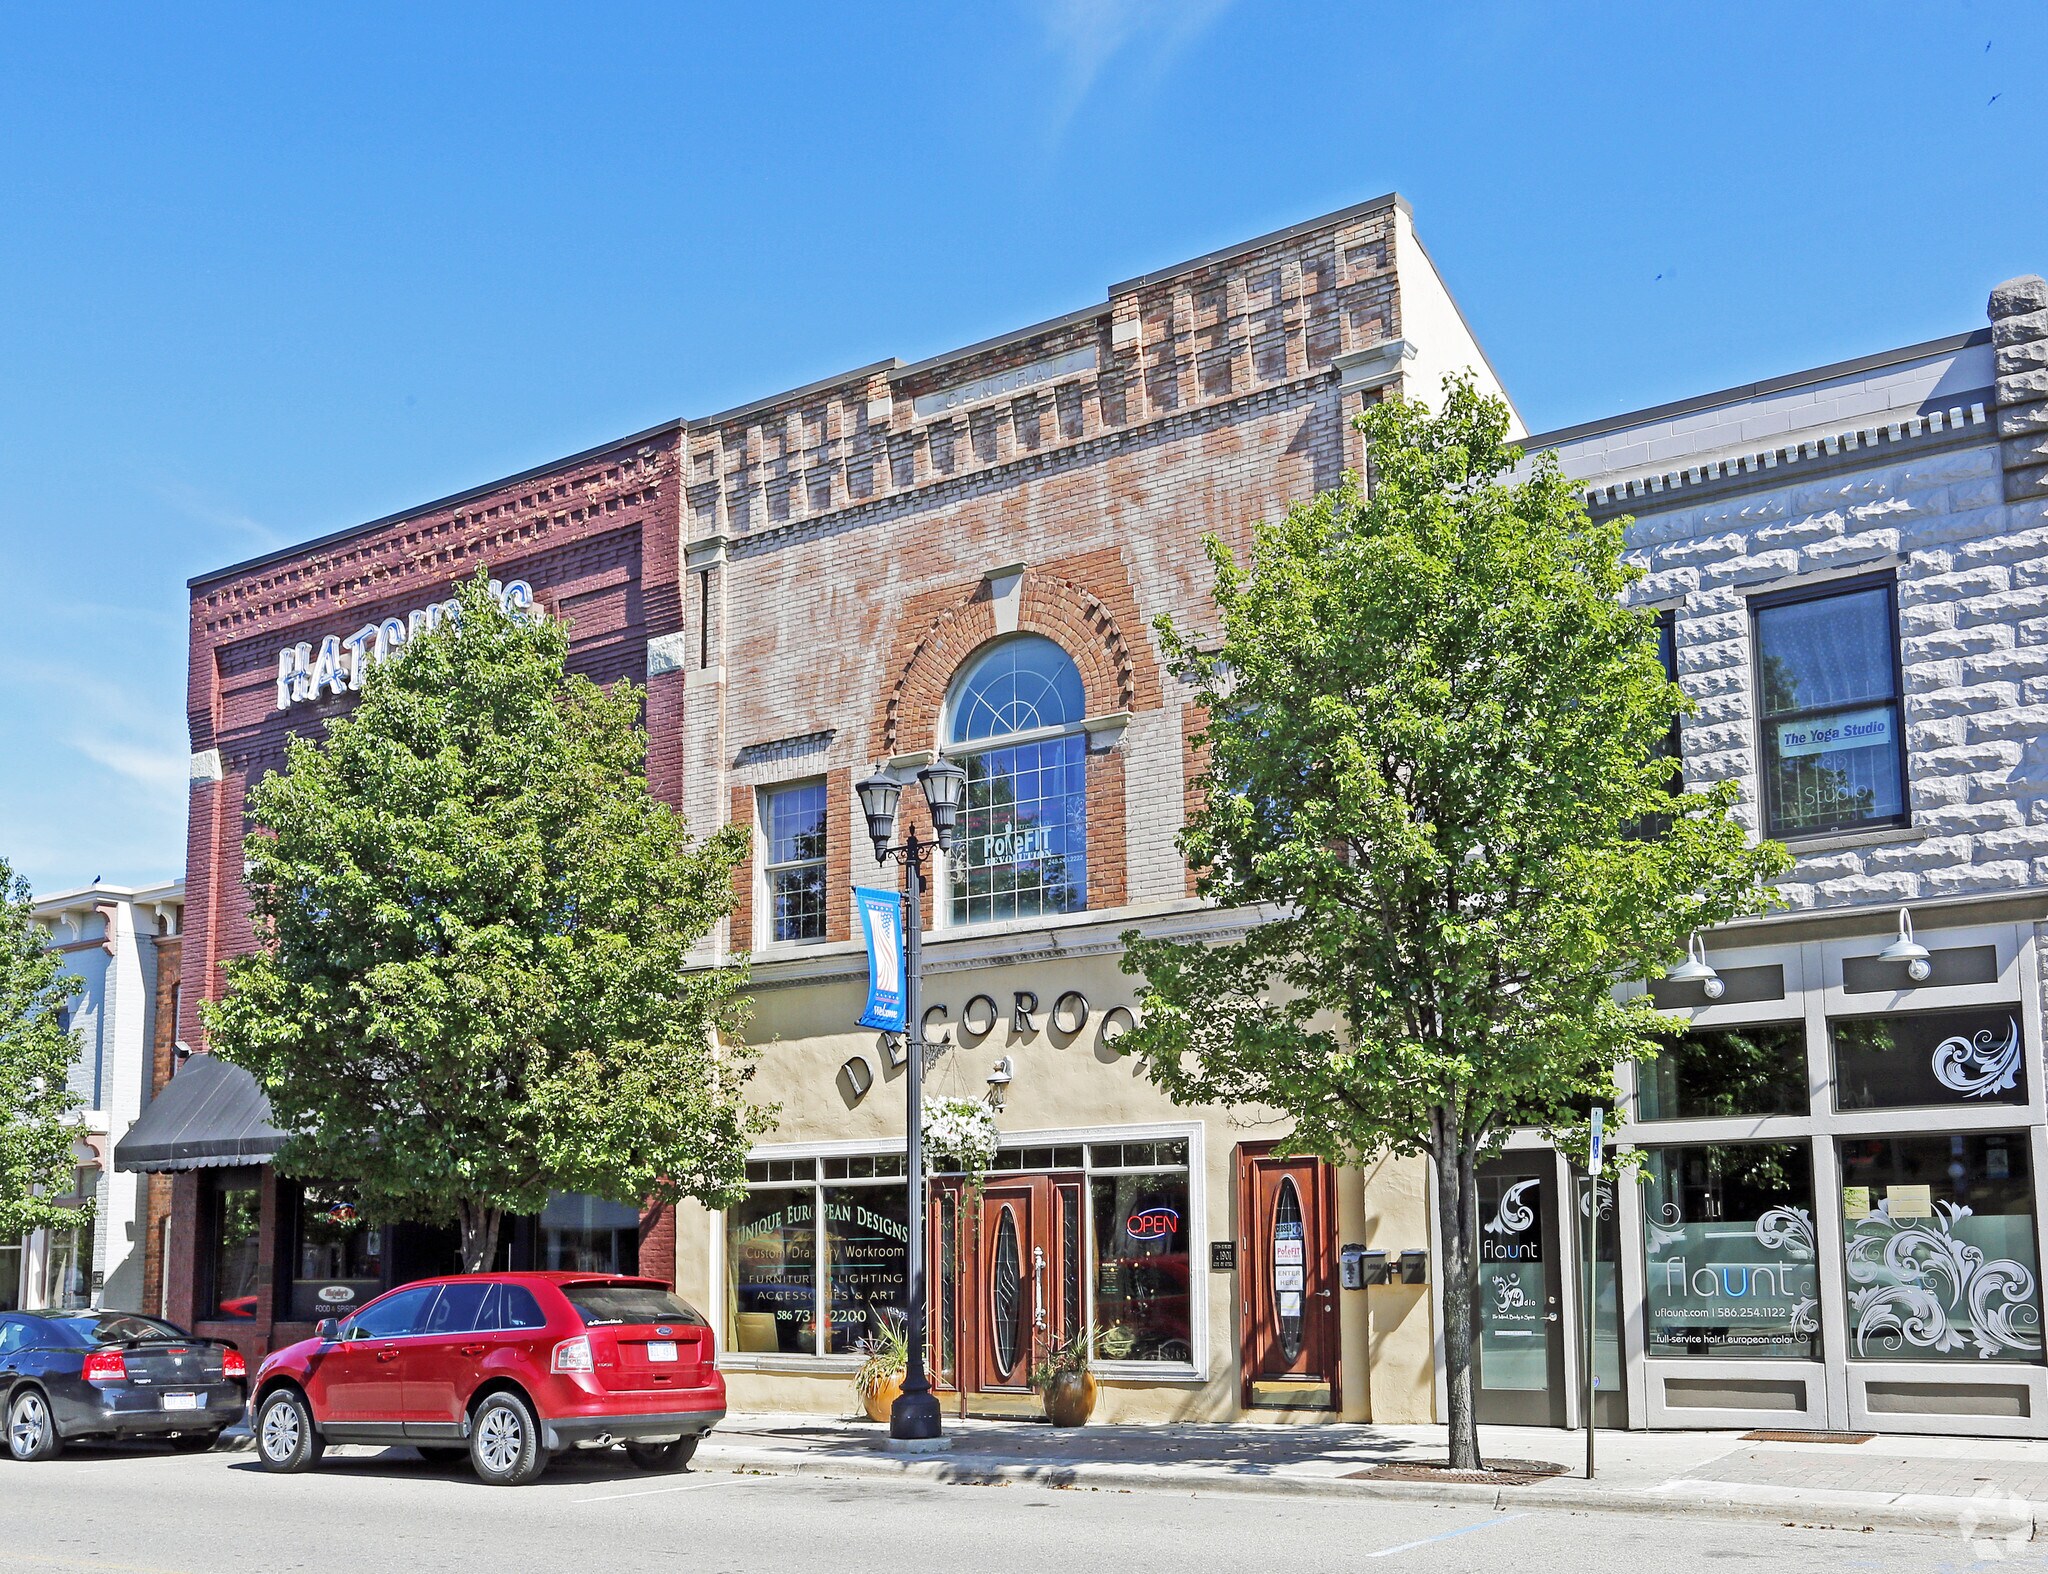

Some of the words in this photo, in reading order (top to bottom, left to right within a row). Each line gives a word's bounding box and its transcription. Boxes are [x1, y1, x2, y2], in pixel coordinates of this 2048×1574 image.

[945, 360, 1061, 409] CENTRAL
[1784, 733, 1806, 745] The
[1810, 728, 1839, 742] Yoga
[1843, 721, 1885, 737] Studio
[873, 1002, 898, 1019] Welcome
[737, 1211, 782, 1245] UNIQUE
[857, 1206, 908, 1243] DESIGNS
[1127, 1215, 1177, 1233] OPEN
[746, 1246, 785, 1259] Custom
[845, 1245, 904, 1258] Workroom
[1484, 1240, 1538, 1259] flaunt
[838, 1273, 903, 1284] LIGHTING
[1666, 1256, 1794, 1297] flaunt
[854, 1291, 863, 1300] &
[869, 1290, 895, 1300] ART
[315, 1305, 330, 1313] FOOD
[777, 1310, 793, 1321] 586
[1655, 1307, 1709, 1318] uflaunt.com
[1717, 1307, 1785, 1318] 586.254.1122
[1656, 1334, 1701, 1344] full-service
[1703, 1334, 1720, 1343] hair
[1727, 1335, 1770, 1346] european
[1771, 1334, 1794, 1344] color
